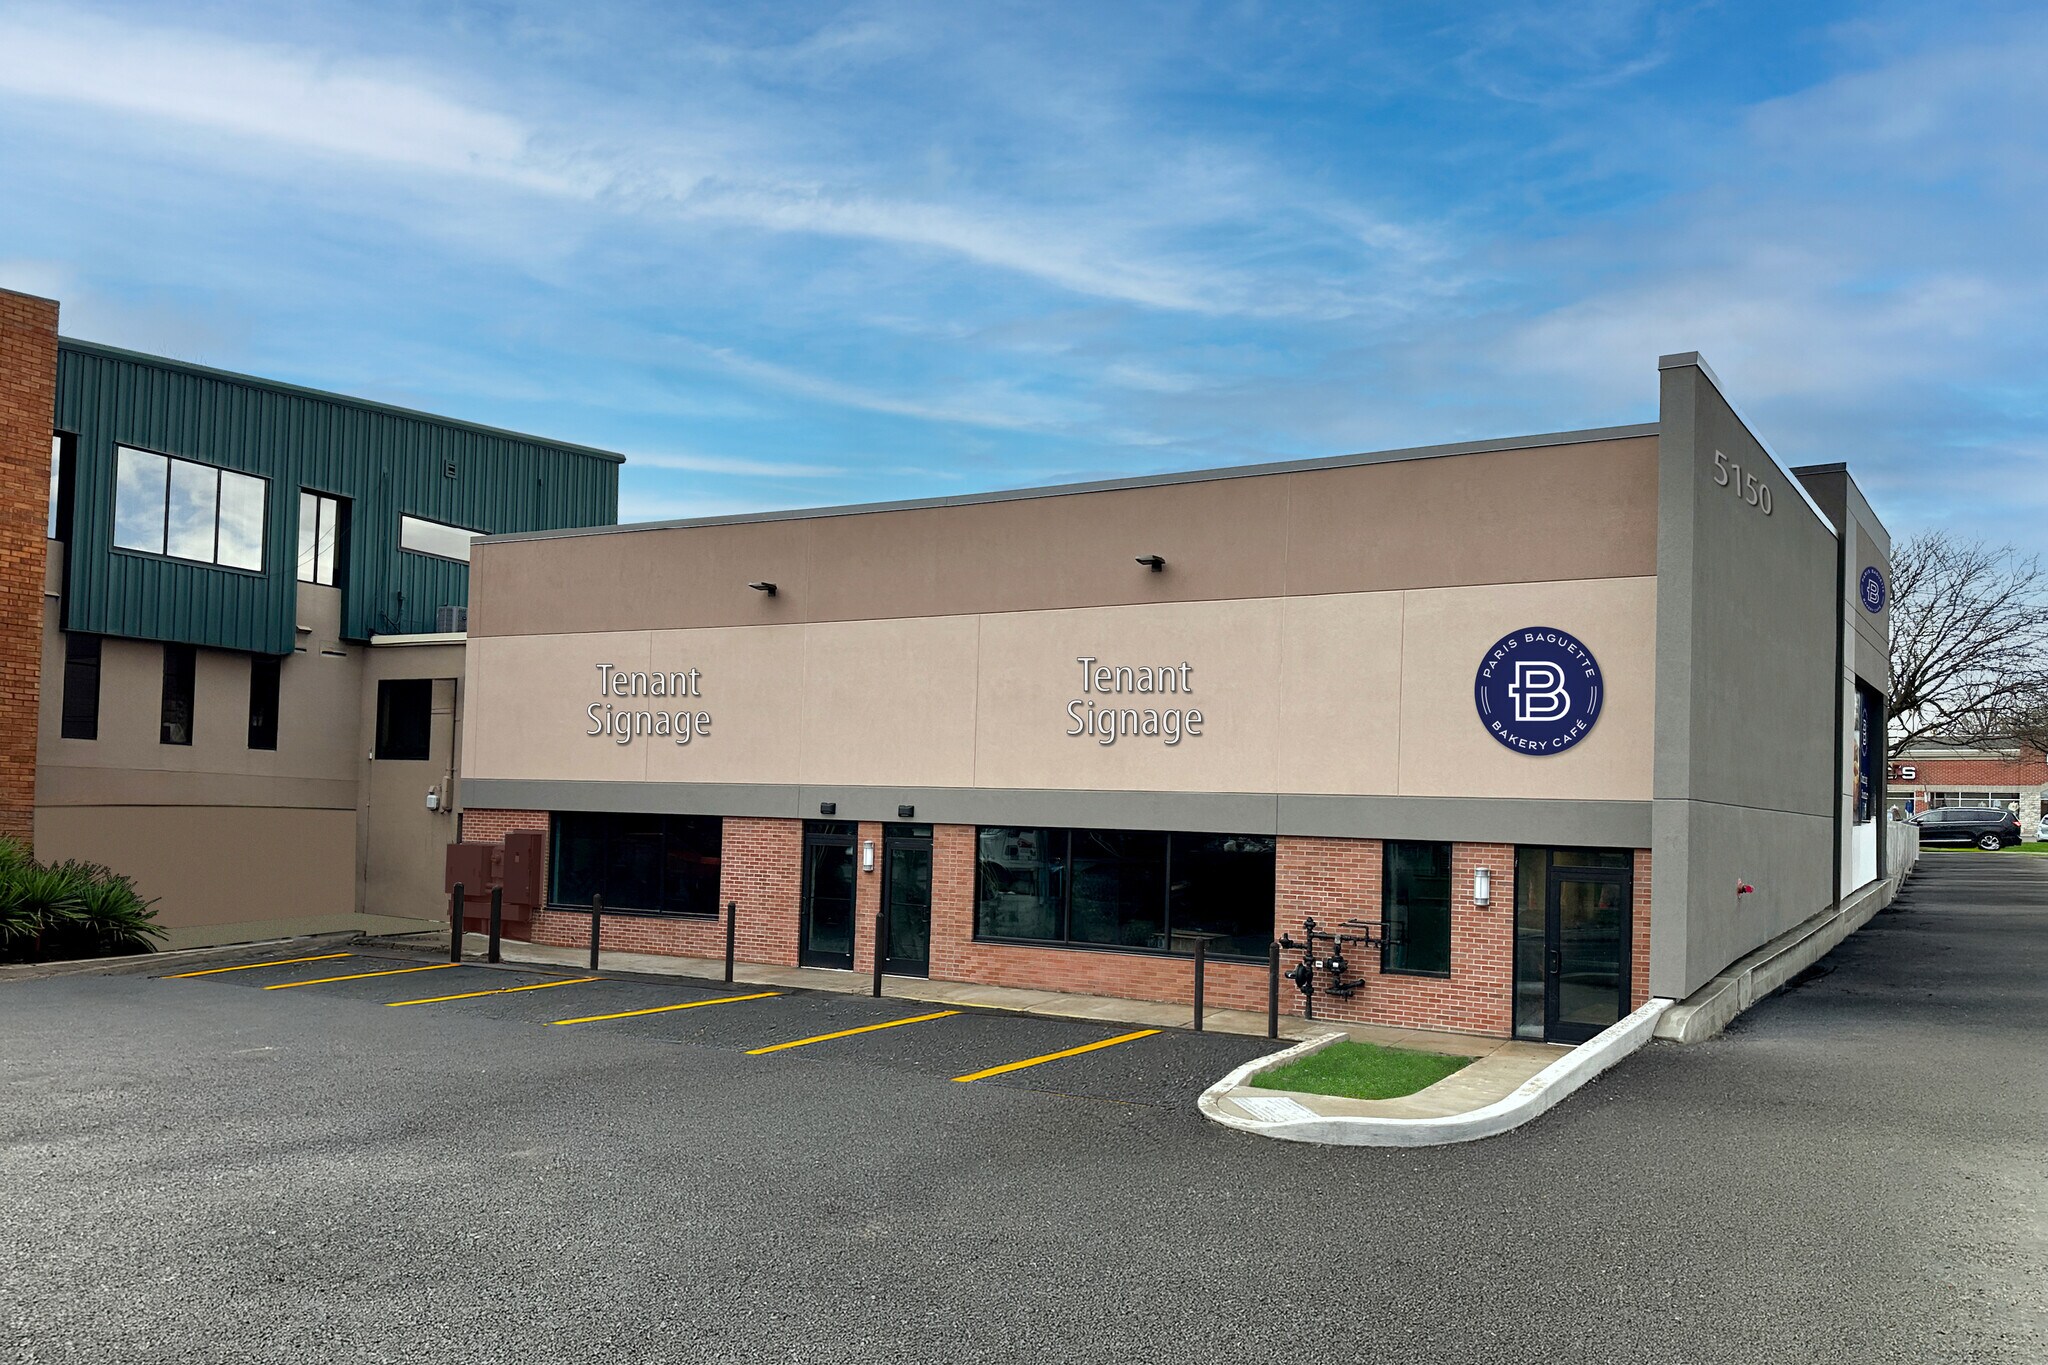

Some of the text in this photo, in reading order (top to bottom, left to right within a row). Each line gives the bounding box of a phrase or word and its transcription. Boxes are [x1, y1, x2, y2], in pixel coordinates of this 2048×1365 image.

[1713, 449, 1772, 515] 5150
[1077, 657, 1192, 693] Tenant
[1483, 633, 1596, 678] PARIS BAGUETTE
[596, 663, 701, 696] Tenant
[586, 702, 711, 744] Signage
[1066, 699, 1203, 745] Signage
[1491, 718, 1587, 750] BAKERY CAFÉ
